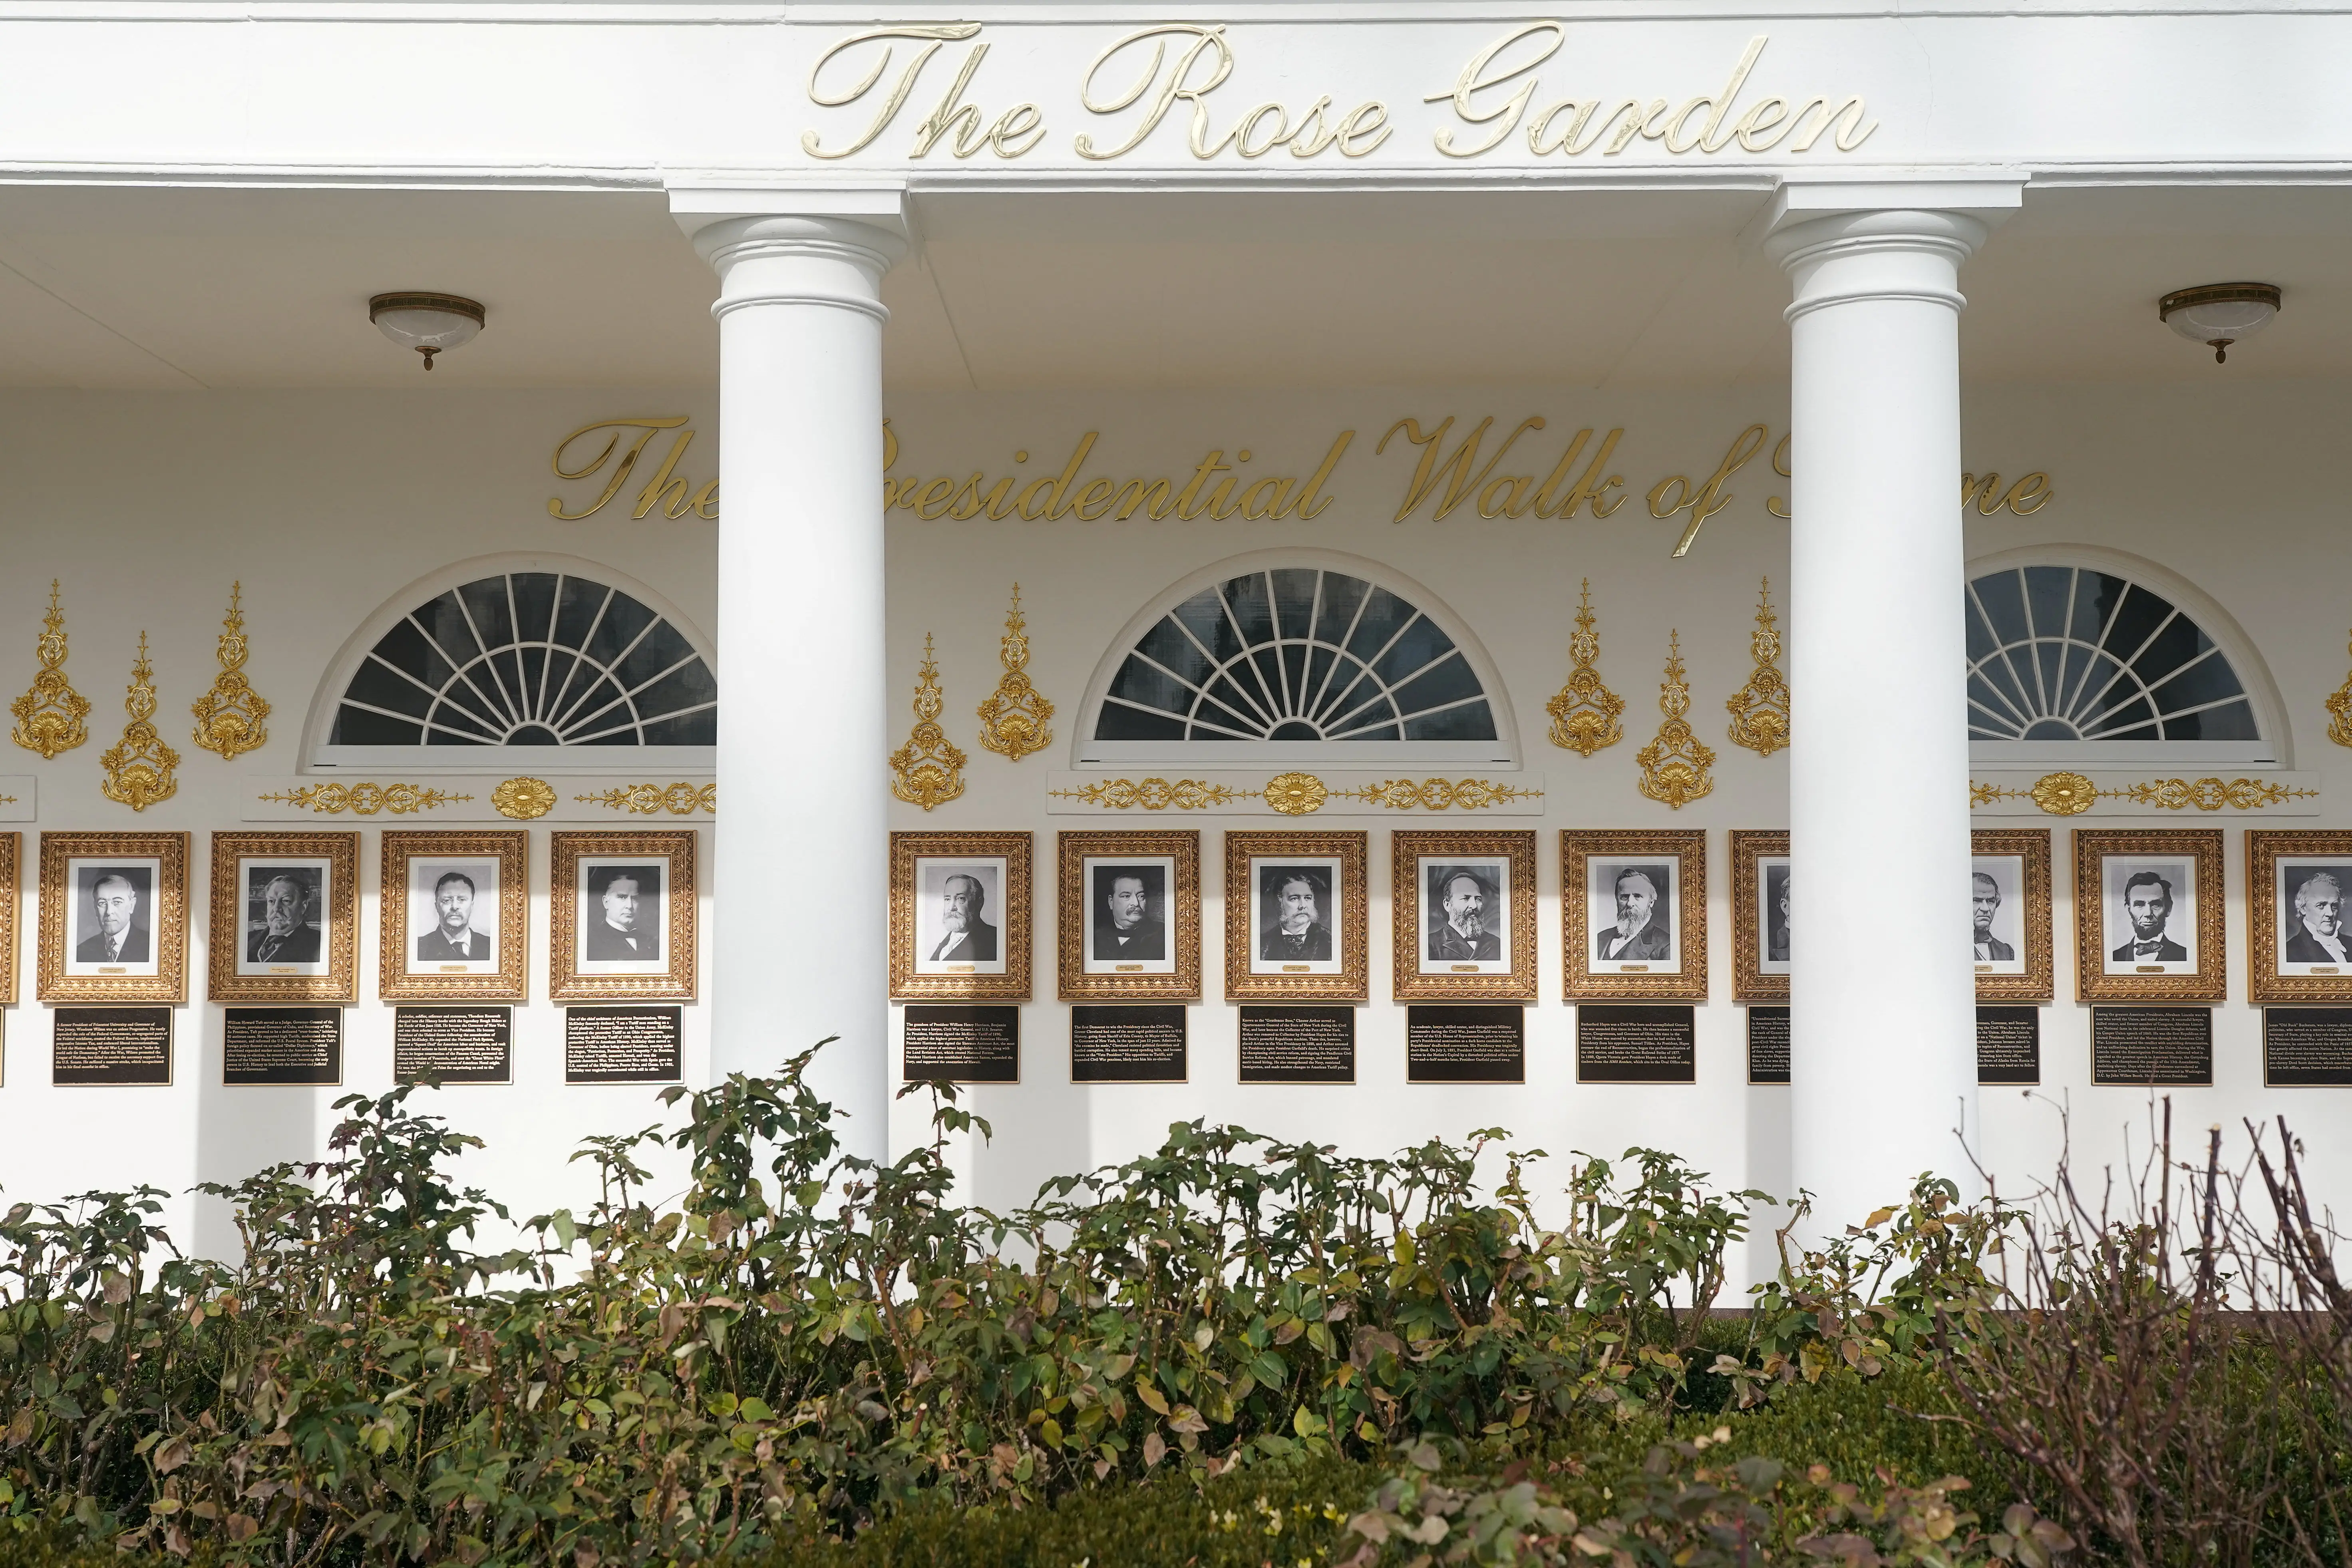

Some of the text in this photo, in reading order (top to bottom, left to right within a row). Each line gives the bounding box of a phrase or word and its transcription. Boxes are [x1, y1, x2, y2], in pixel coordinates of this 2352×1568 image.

[801, 20, 1879, 161] The Rose Garden
[547, 416, 718, 519] The
[881, 418, 1355, 522] residential
[1376, 415, 1628, 524] Walk
[1648, 423, 1767, 558] of
